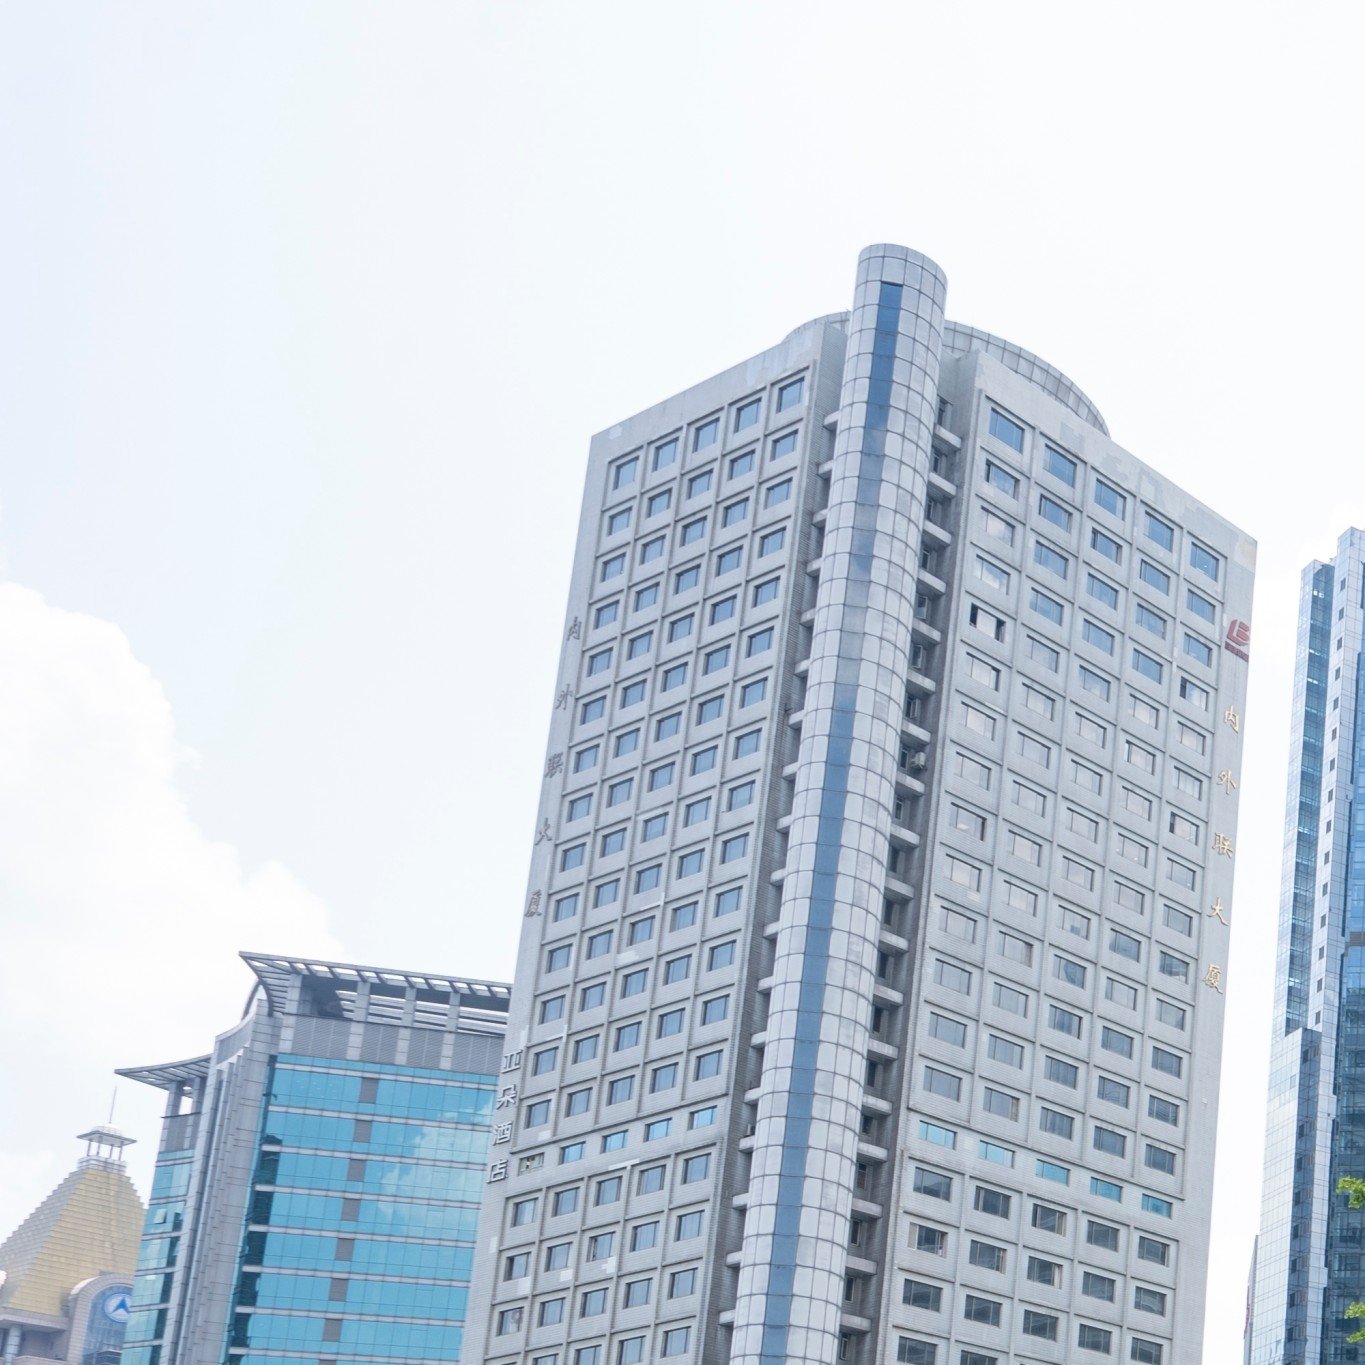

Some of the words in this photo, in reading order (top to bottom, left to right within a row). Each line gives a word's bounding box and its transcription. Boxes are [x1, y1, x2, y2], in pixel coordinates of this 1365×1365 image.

[1202, 705, 1240, 994] 内外联大厦
[486, 1050, 523, 1183] 亚朵酒店
